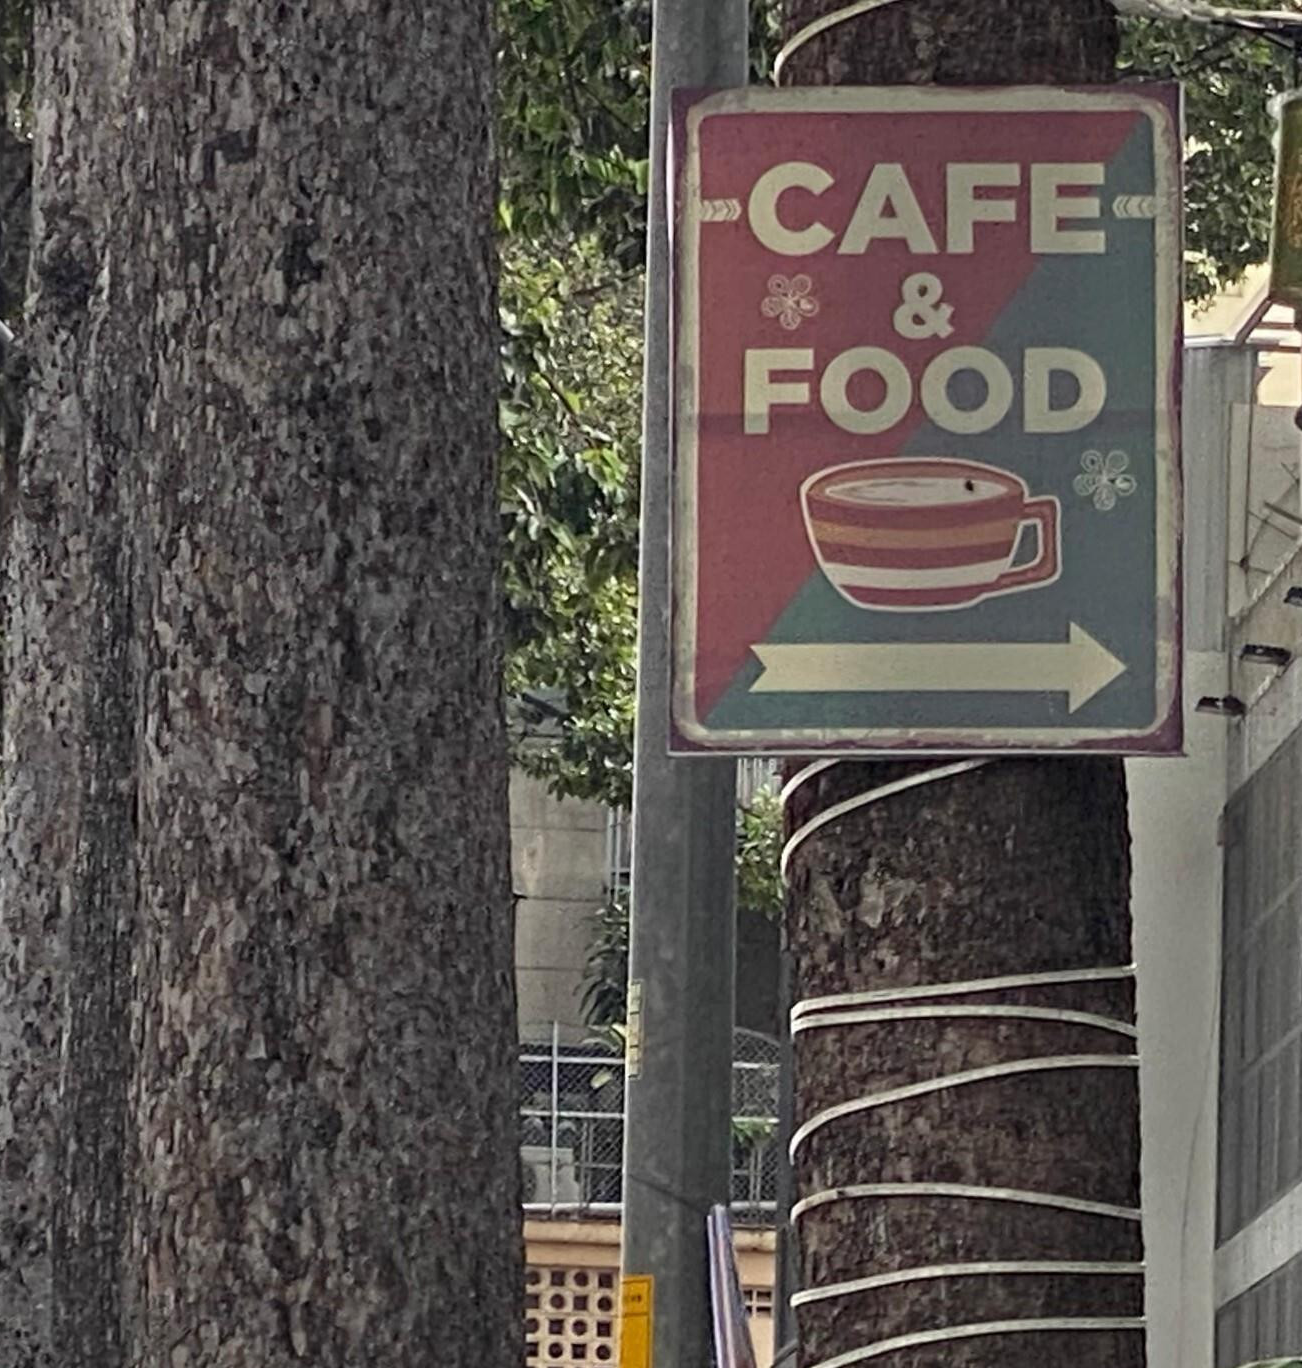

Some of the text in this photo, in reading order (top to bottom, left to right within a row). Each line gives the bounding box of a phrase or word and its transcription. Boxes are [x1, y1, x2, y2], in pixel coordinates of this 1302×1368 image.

[748, 161, 1107, 256] CAFE
[893, 272, 955, 340] &
[743, 348, 1107, 436] FOOD
